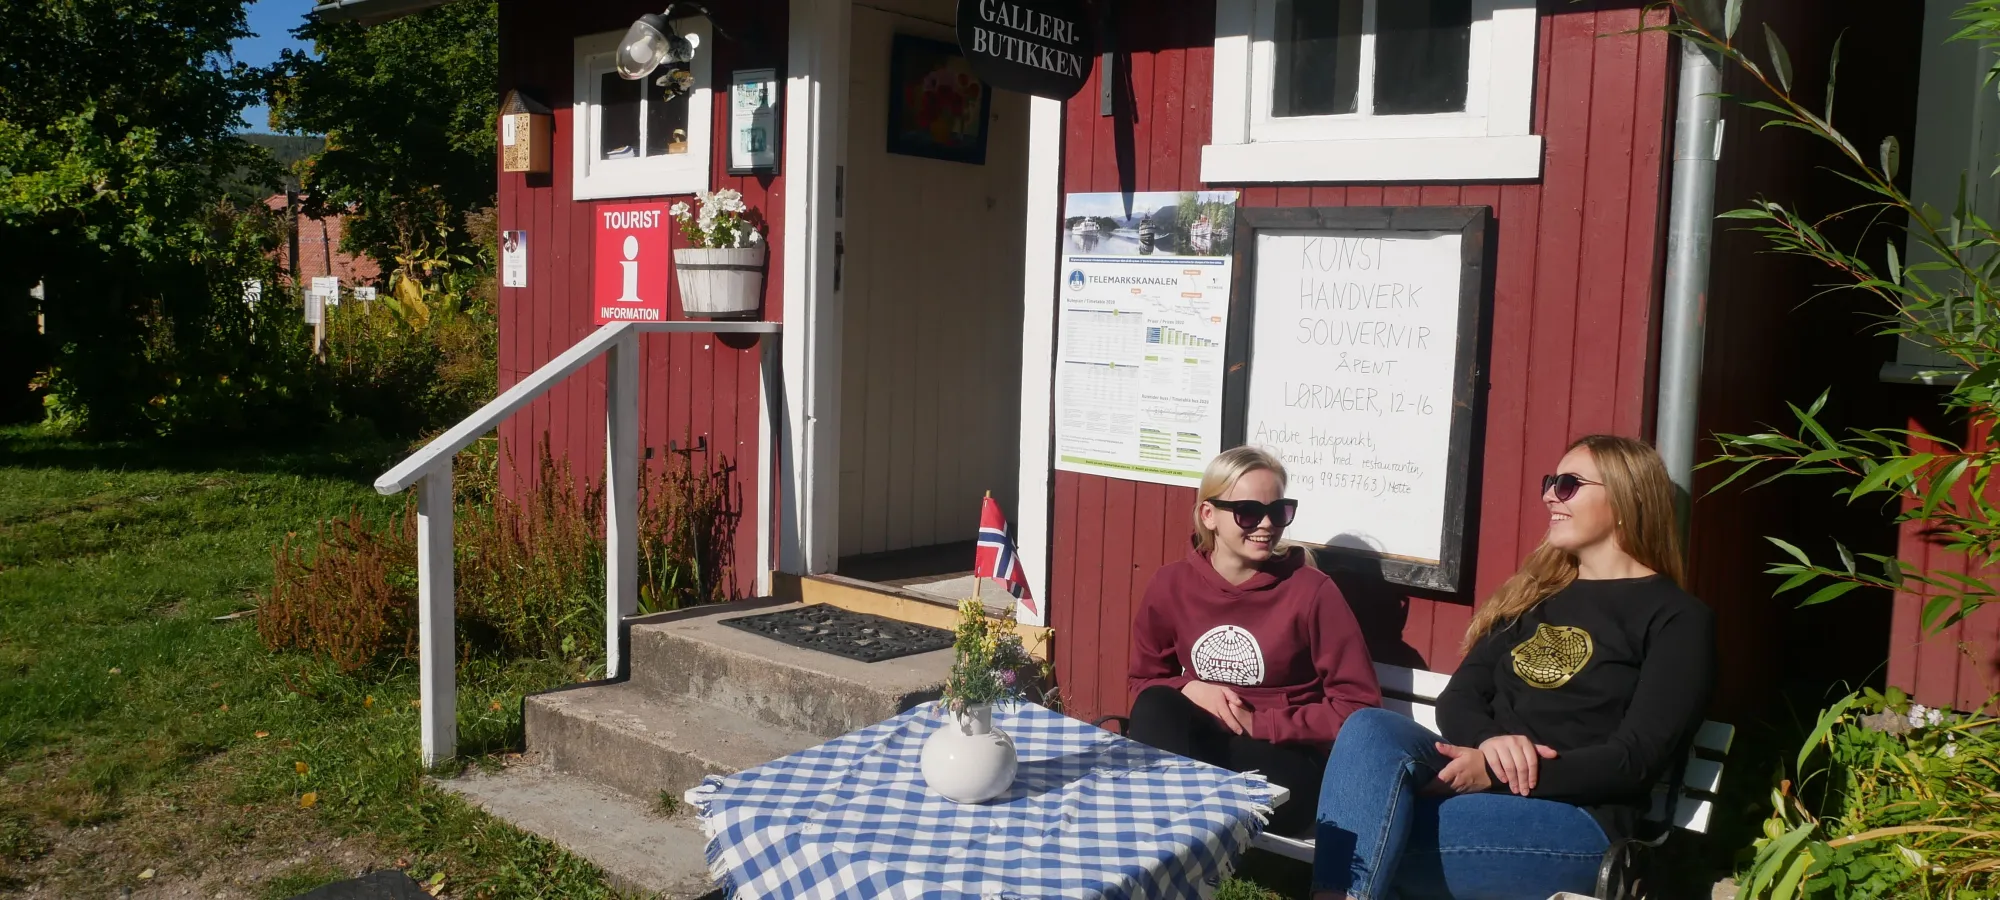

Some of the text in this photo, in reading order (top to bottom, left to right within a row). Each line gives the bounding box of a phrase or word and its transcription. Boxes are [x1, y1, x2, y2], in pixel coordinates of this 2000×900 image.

[979, 0, 1080, 45] GALLERI-
[972, 26, 1083, 79] BUTIKKEN
[603, 210, 661, 229] TOURIST
[1302, 235, 1396, 272] KUNST
[1089, 275, 1178, 287] TELEMARKSKANALEN
[1300, 277, 1423, 311] HANDVERK
[601, 306, 660, 321] INFORMATION
[1297, 317, 1431, 350] SOUVERNIR
[1335, 352, 1398, 376] ÅPENT
[1285, 381, 1433, 417] LØRDAGER, 12-16
[1255, 420, 1376, 453] Andre tidspunkt,
[1280, 448, 1323, 465] kontakt
[1333, 452, 1353, 466] med
[1290, 473, 1314, 491] ring
